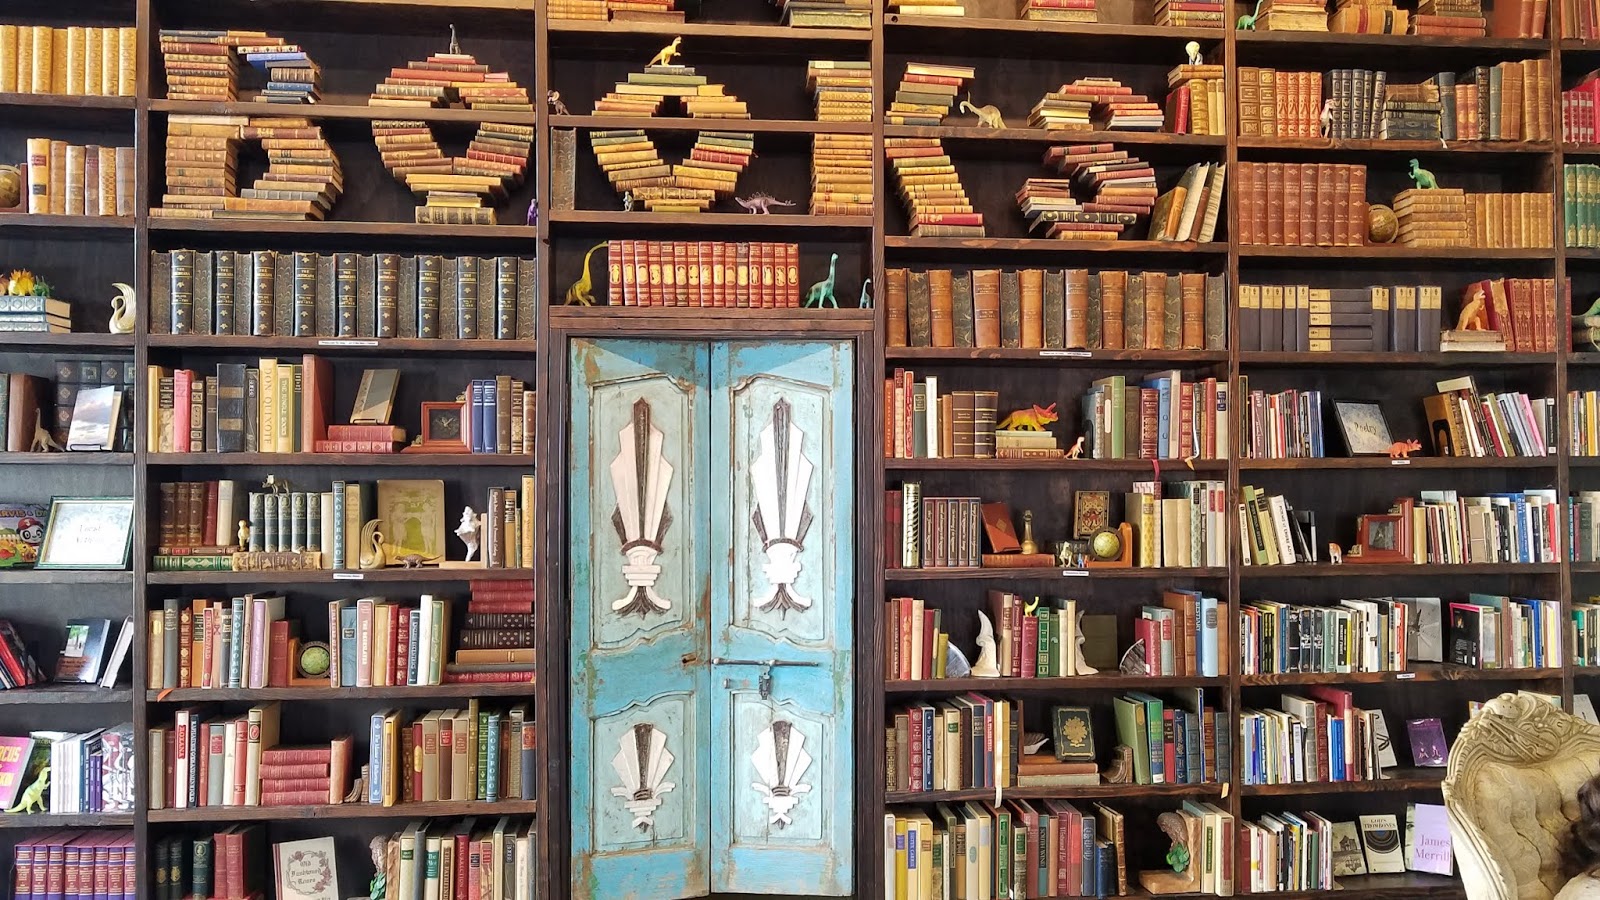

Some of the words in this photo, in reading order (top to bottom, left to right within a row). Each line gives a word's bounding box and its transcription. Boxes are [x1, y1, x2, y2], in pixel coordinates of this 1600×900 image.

[263, 367, 273, 391] DON
[263, 397, 273, 445] QUIXOTE
[1354, 421, 1377, 435] Poetry
[0, 509, 26, 517] RVIS
[178, 727, 186, 758] ROXANA
[488, 730, 496, 789] NOSTROMO
[1420, 834, 1451, 847] James
[1415, 848, 1450, 861] Merrill
